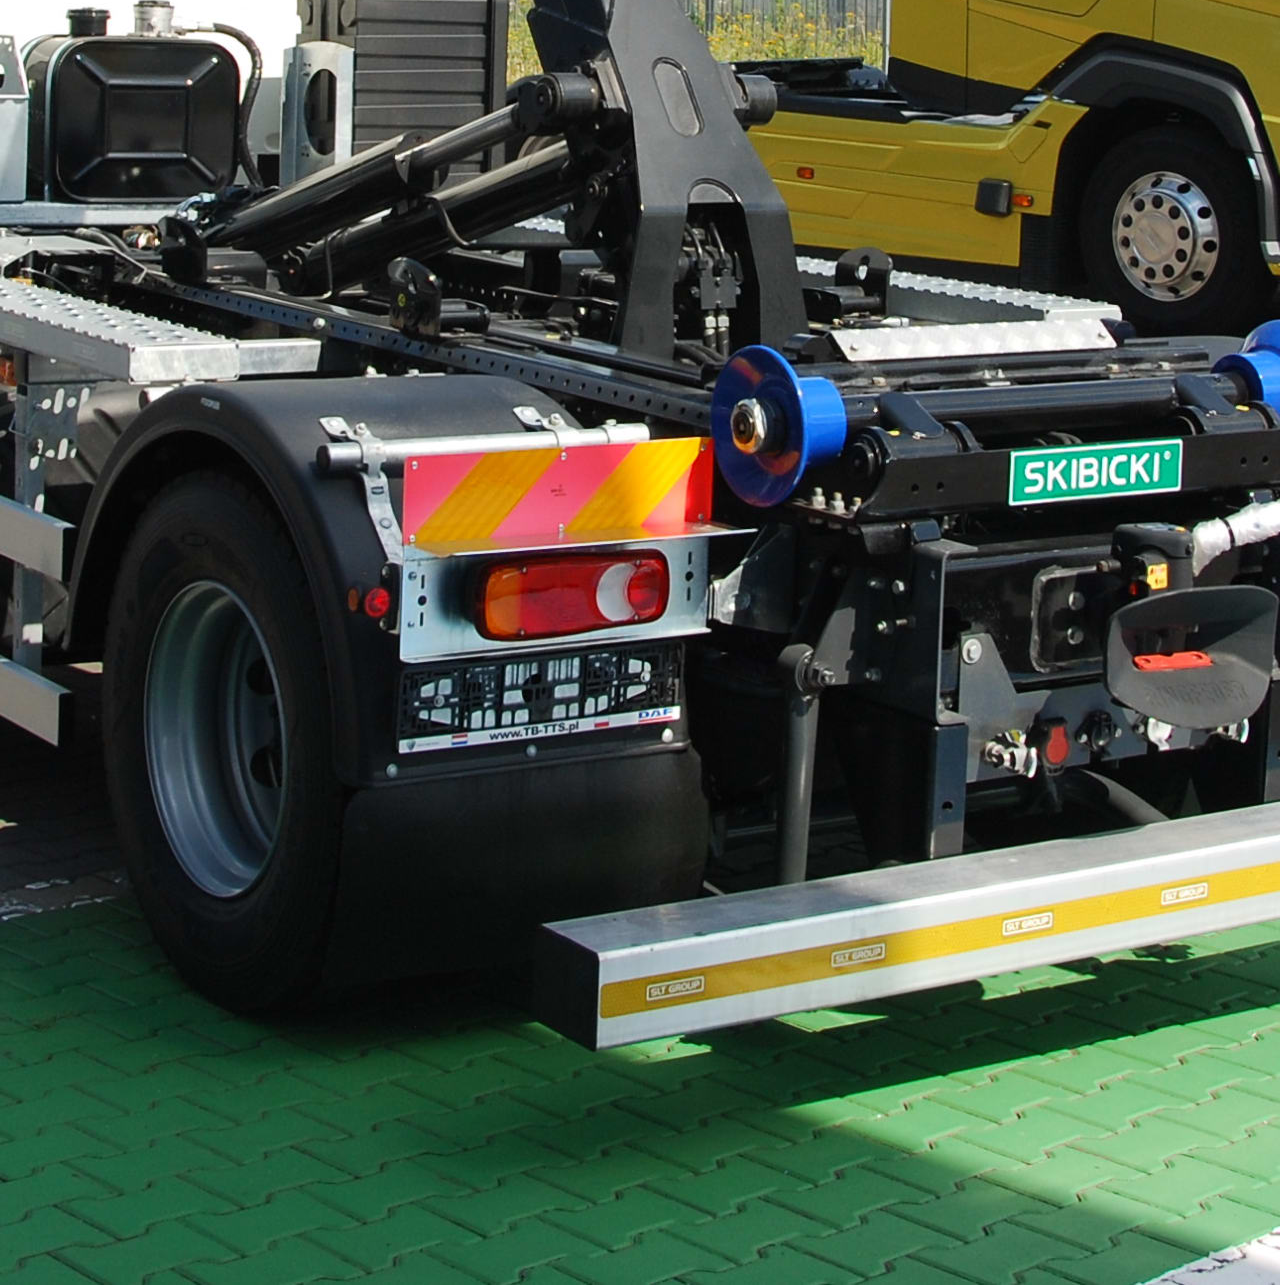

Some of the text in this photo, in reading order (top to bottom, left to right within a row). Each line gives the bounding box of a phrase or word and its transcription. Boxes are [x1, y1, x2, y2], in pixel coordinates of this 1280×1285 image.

[1023, 451, 1161, 494] SKIBICKI
[638, 707, 673, 719] DAF
[489, 721, 580, 741] www.TB-TTS.pl
[1006, 916, 1050, 931] SLT GROUP
[835, 948, 882, 964] SLT GROUP
[650, 980, 701, 997] SLT GROUP
